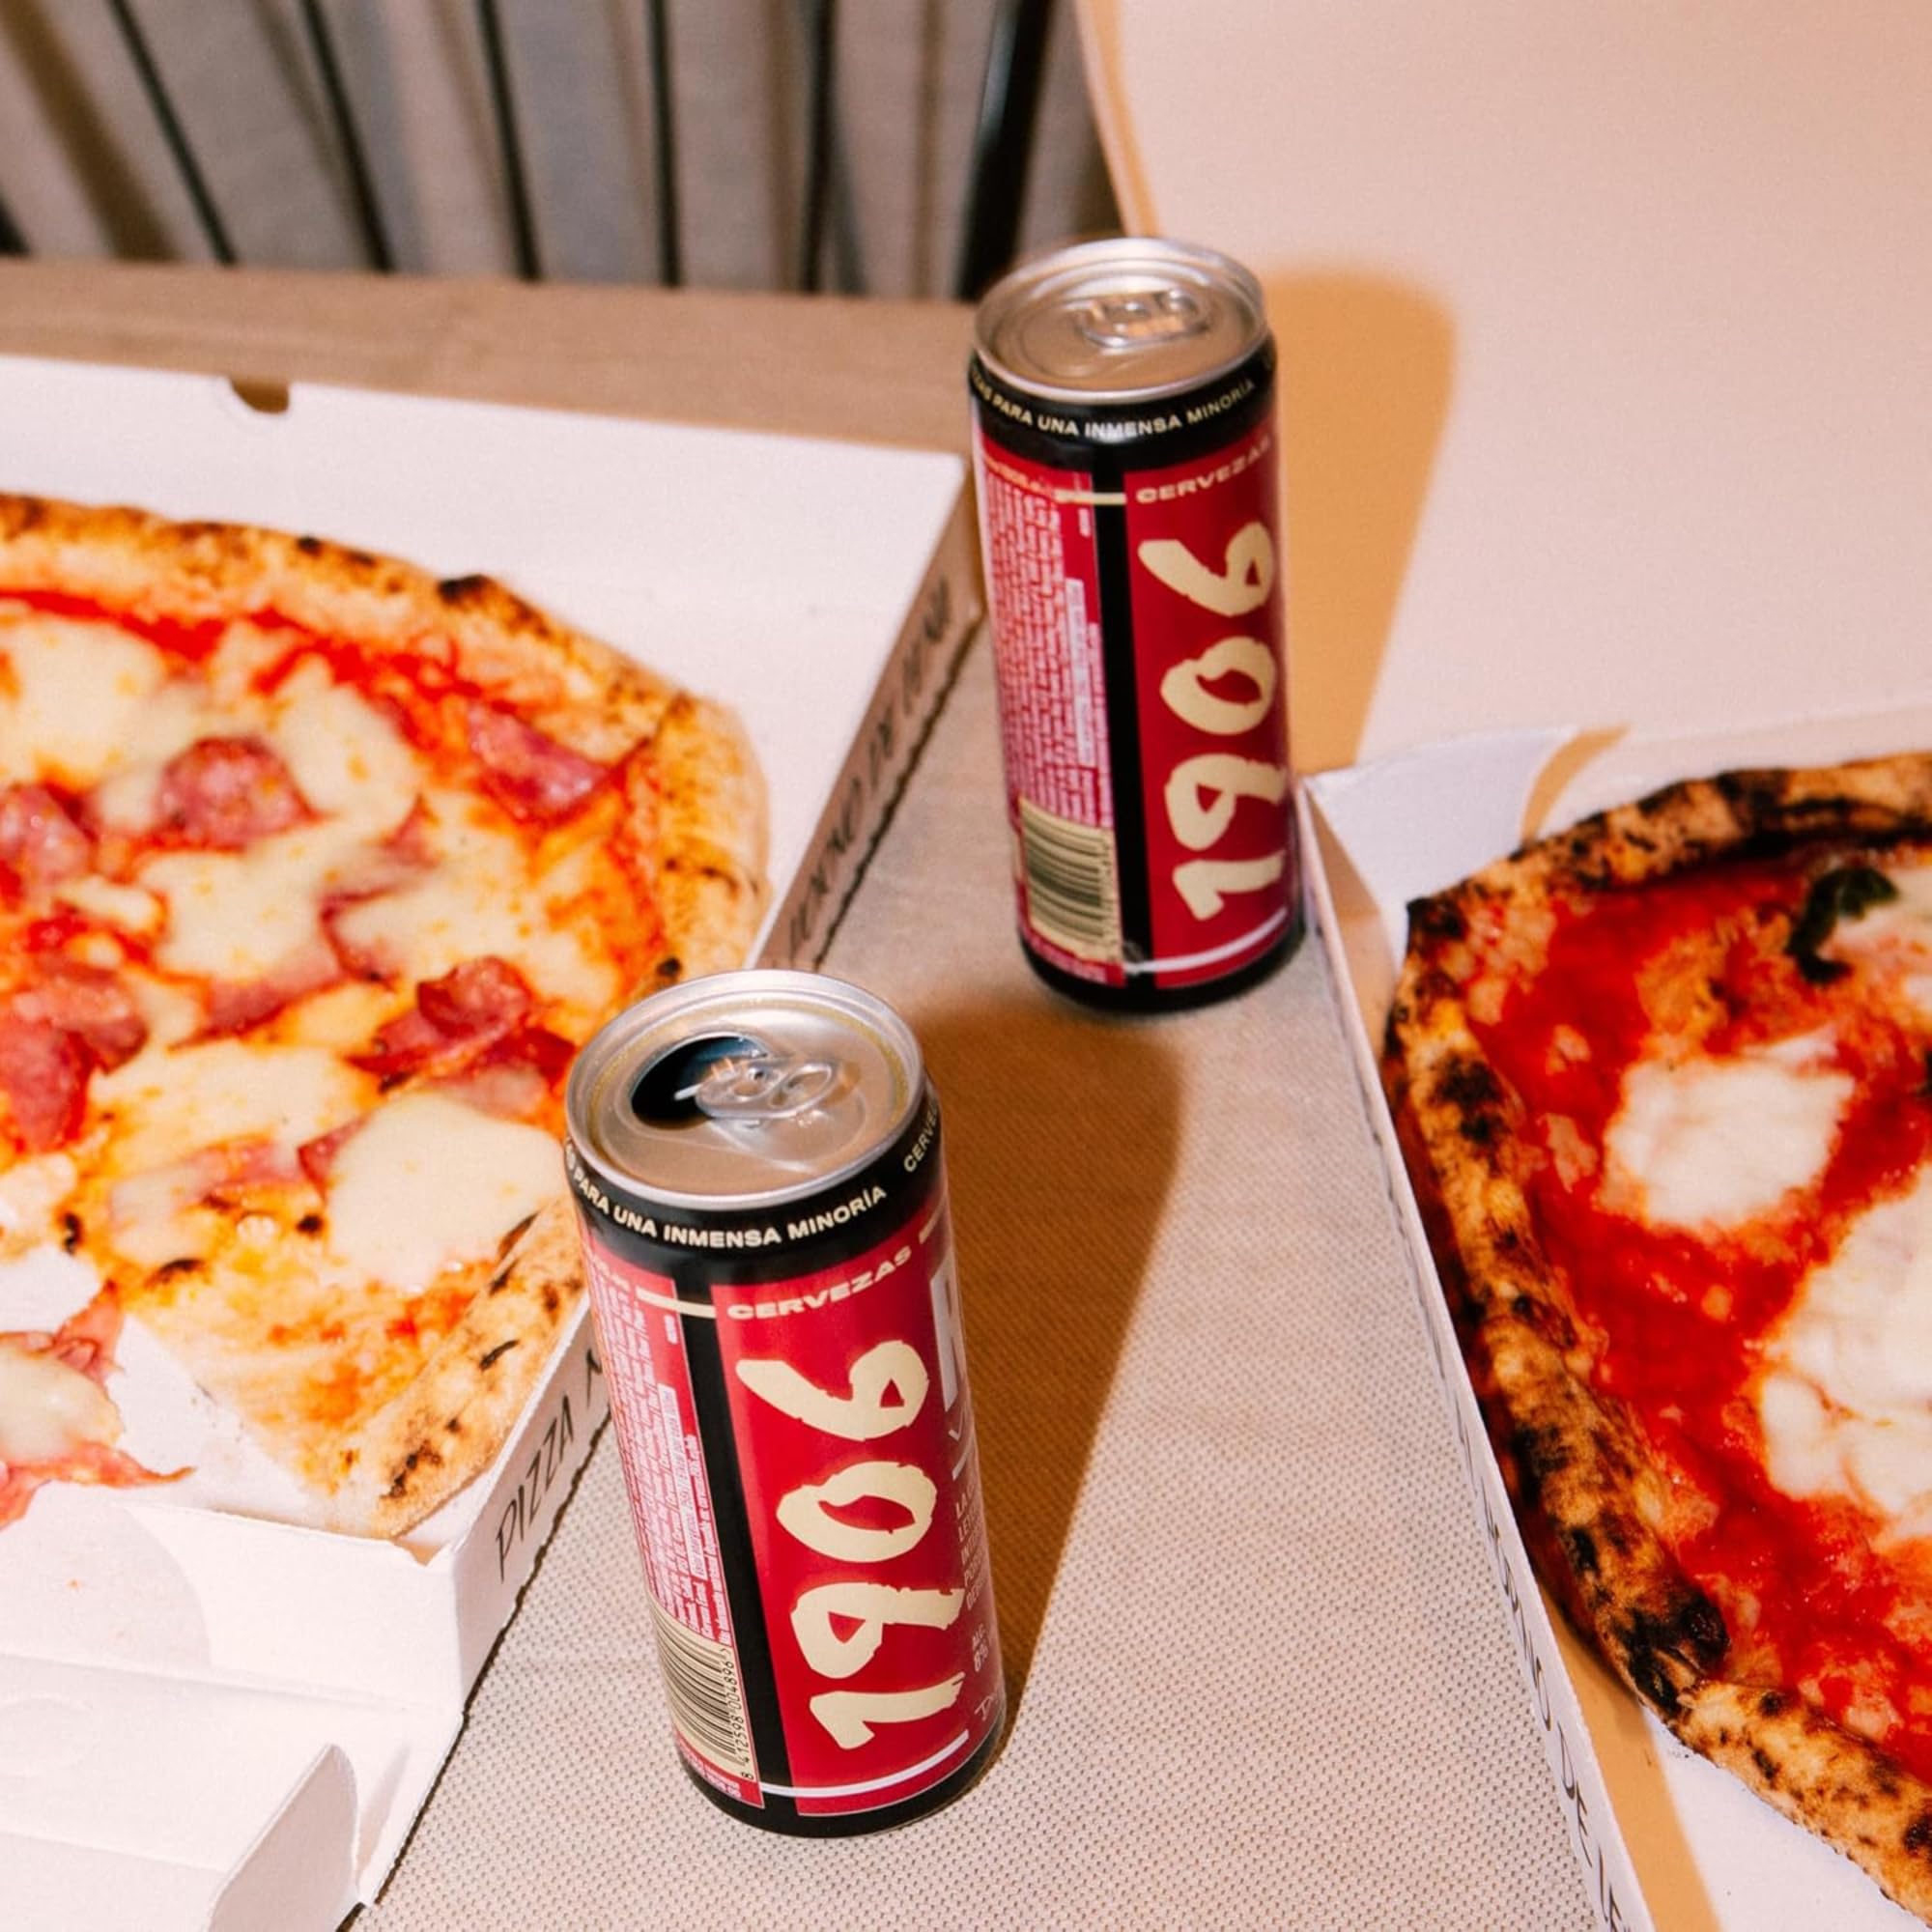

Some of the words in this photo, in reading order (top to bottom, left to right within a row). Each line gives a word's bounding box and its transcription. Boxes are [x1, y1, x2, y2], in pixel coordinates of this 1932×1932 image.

[992, 394, 1033, 426] PARA
[1037, 414, 1080, 437] UNA
[1085, 412, 1183, 444] INMENSA
[1138, 522, 1286, 921] 1906
[574, 1166, 610, 1215] PARA
[613, 1205, 657, 1237] UNA
[663, 1223, 781, 1249] INMENSA
[787, 1184, 888, 1241] MINORÍA
[727, 1244, 913, 1321] CERVEZAS
[496, 1394, 575, 1583] PIZZA
[736, 1340, 967, 1750] 1906
